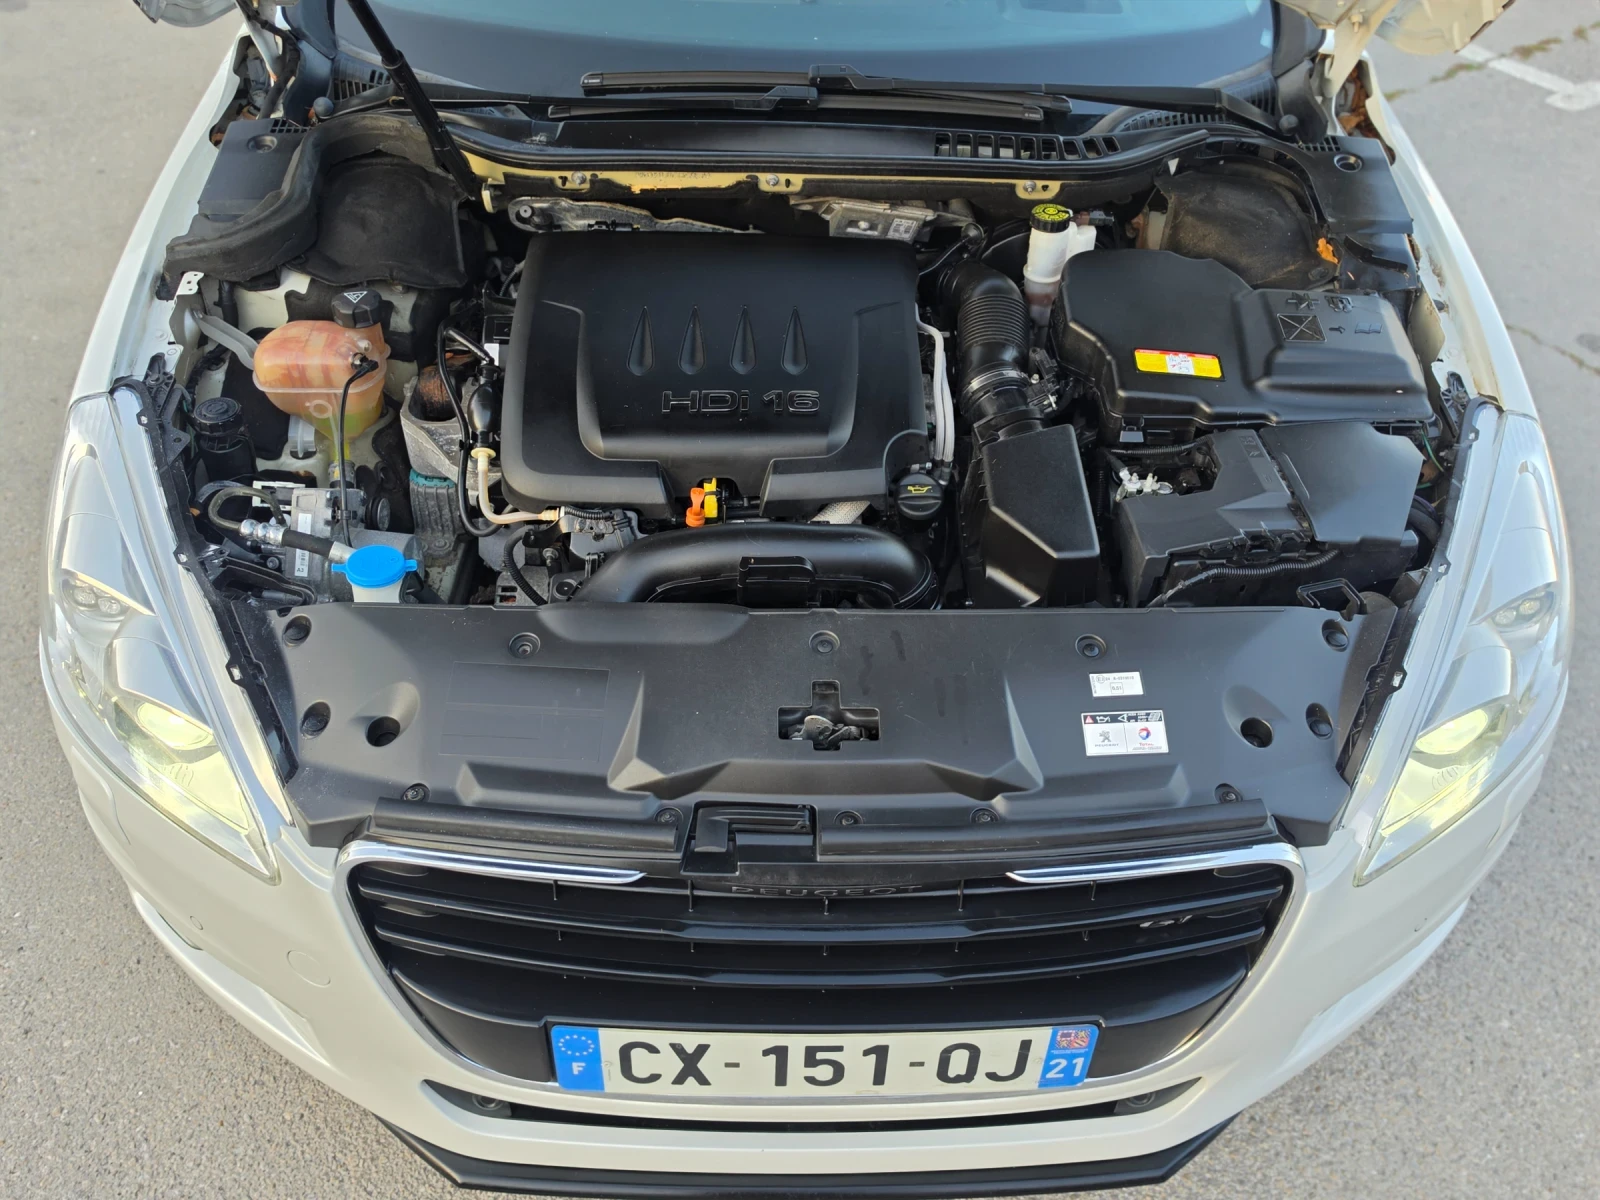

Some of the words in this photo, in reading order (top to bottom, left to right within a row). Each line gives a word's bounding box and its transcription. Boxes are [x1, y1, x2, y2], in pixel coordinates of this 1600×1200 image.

[662, 390, 749, 412] HDi
[763, 390, 820, 413] 16
[731, 885, 923, 897] PEUGEOT
[571, 1062, 586, 1075] F
[1045, 1057, 1085, 1079] 21
